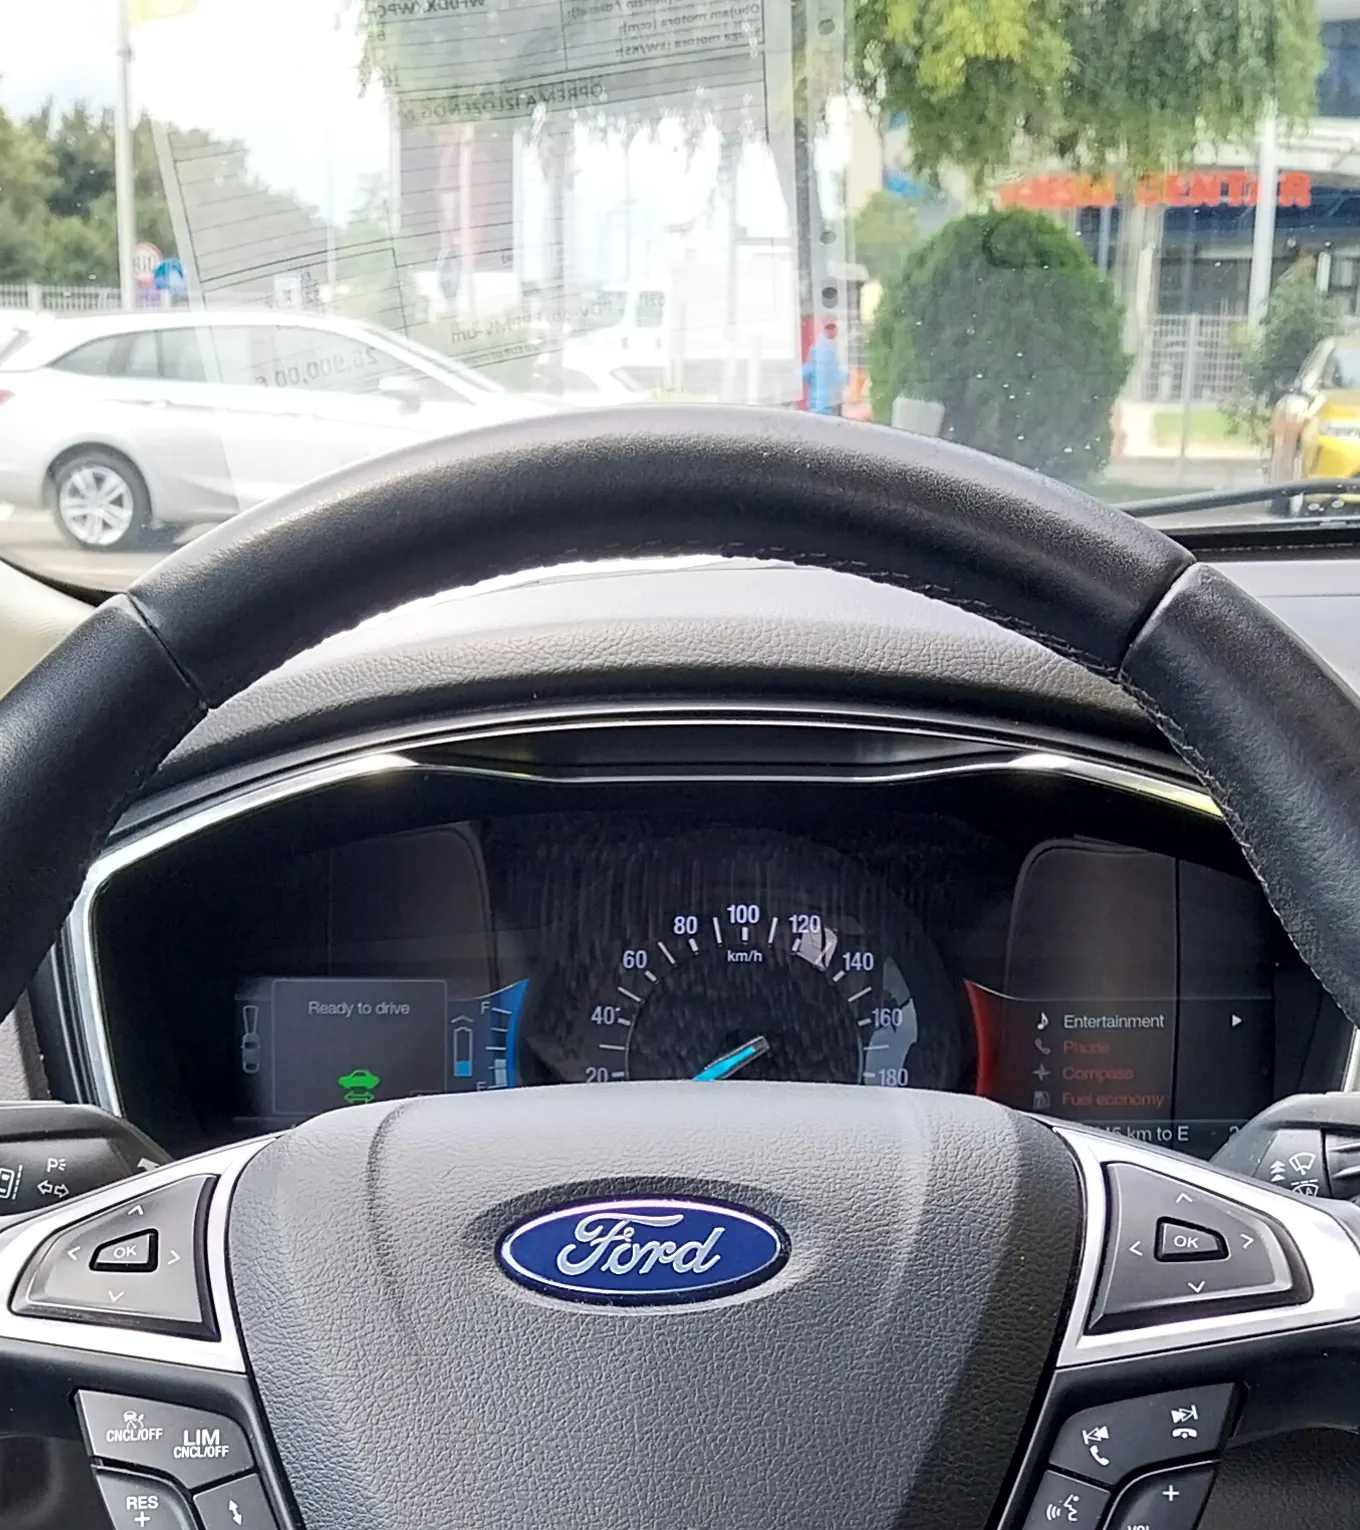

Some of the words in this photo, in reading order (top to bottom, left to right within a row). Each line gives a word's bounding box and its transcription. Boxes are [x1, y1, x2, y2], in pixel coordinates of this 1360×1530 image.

[1136, 172, 1311, 206] CENTR
[727, 905, 760, 924] 100
[673, 916, 698, 935] 80
[790, 915, 822, 934] 120
[623, 950, 647, 969] 60
[727, 950, 763, 963] km/h
[843, 952, 874, 971] 140
[308, 1002, 353, 1018] Ready
[358, 1003, 372, 1015] to
[375, 1001, 411, 1015] drive
[480, 1002, 490, 1015] F
[591, 1006, 616, 1025] 40
[871, 1008, 903, 1028] 160
[1063, 1014, 1165, 1029] Entertainment
[1063, 1040, 1112, 1055] Phone
[586, 1067, 609, 1083] 20
[878, 1069, 908, 1087] 180
[1062, 1067, 1134, 1082] Compass
[1062, 1092, 1095, 1107] Fuel
[1096, 1094, 1164, 1110] economy
[1127, 1126, 1152, 1142] km
[1157, 1126, 1173, 1141] to
[1178, 1126, 1189, 1141] E
[557, 1212, 725, 1276] Ford
[1173, 1234, 1198, 1249] OK
[113, 1245, 138, 1259] OK
[106, 1427, 164, 1443] CNCL/OFF
[183, 1429, 220, 1446] LIM
[173, 1445, 230, 1459] CNCL/OFF
[126, 1496, 159, 1511] RES
